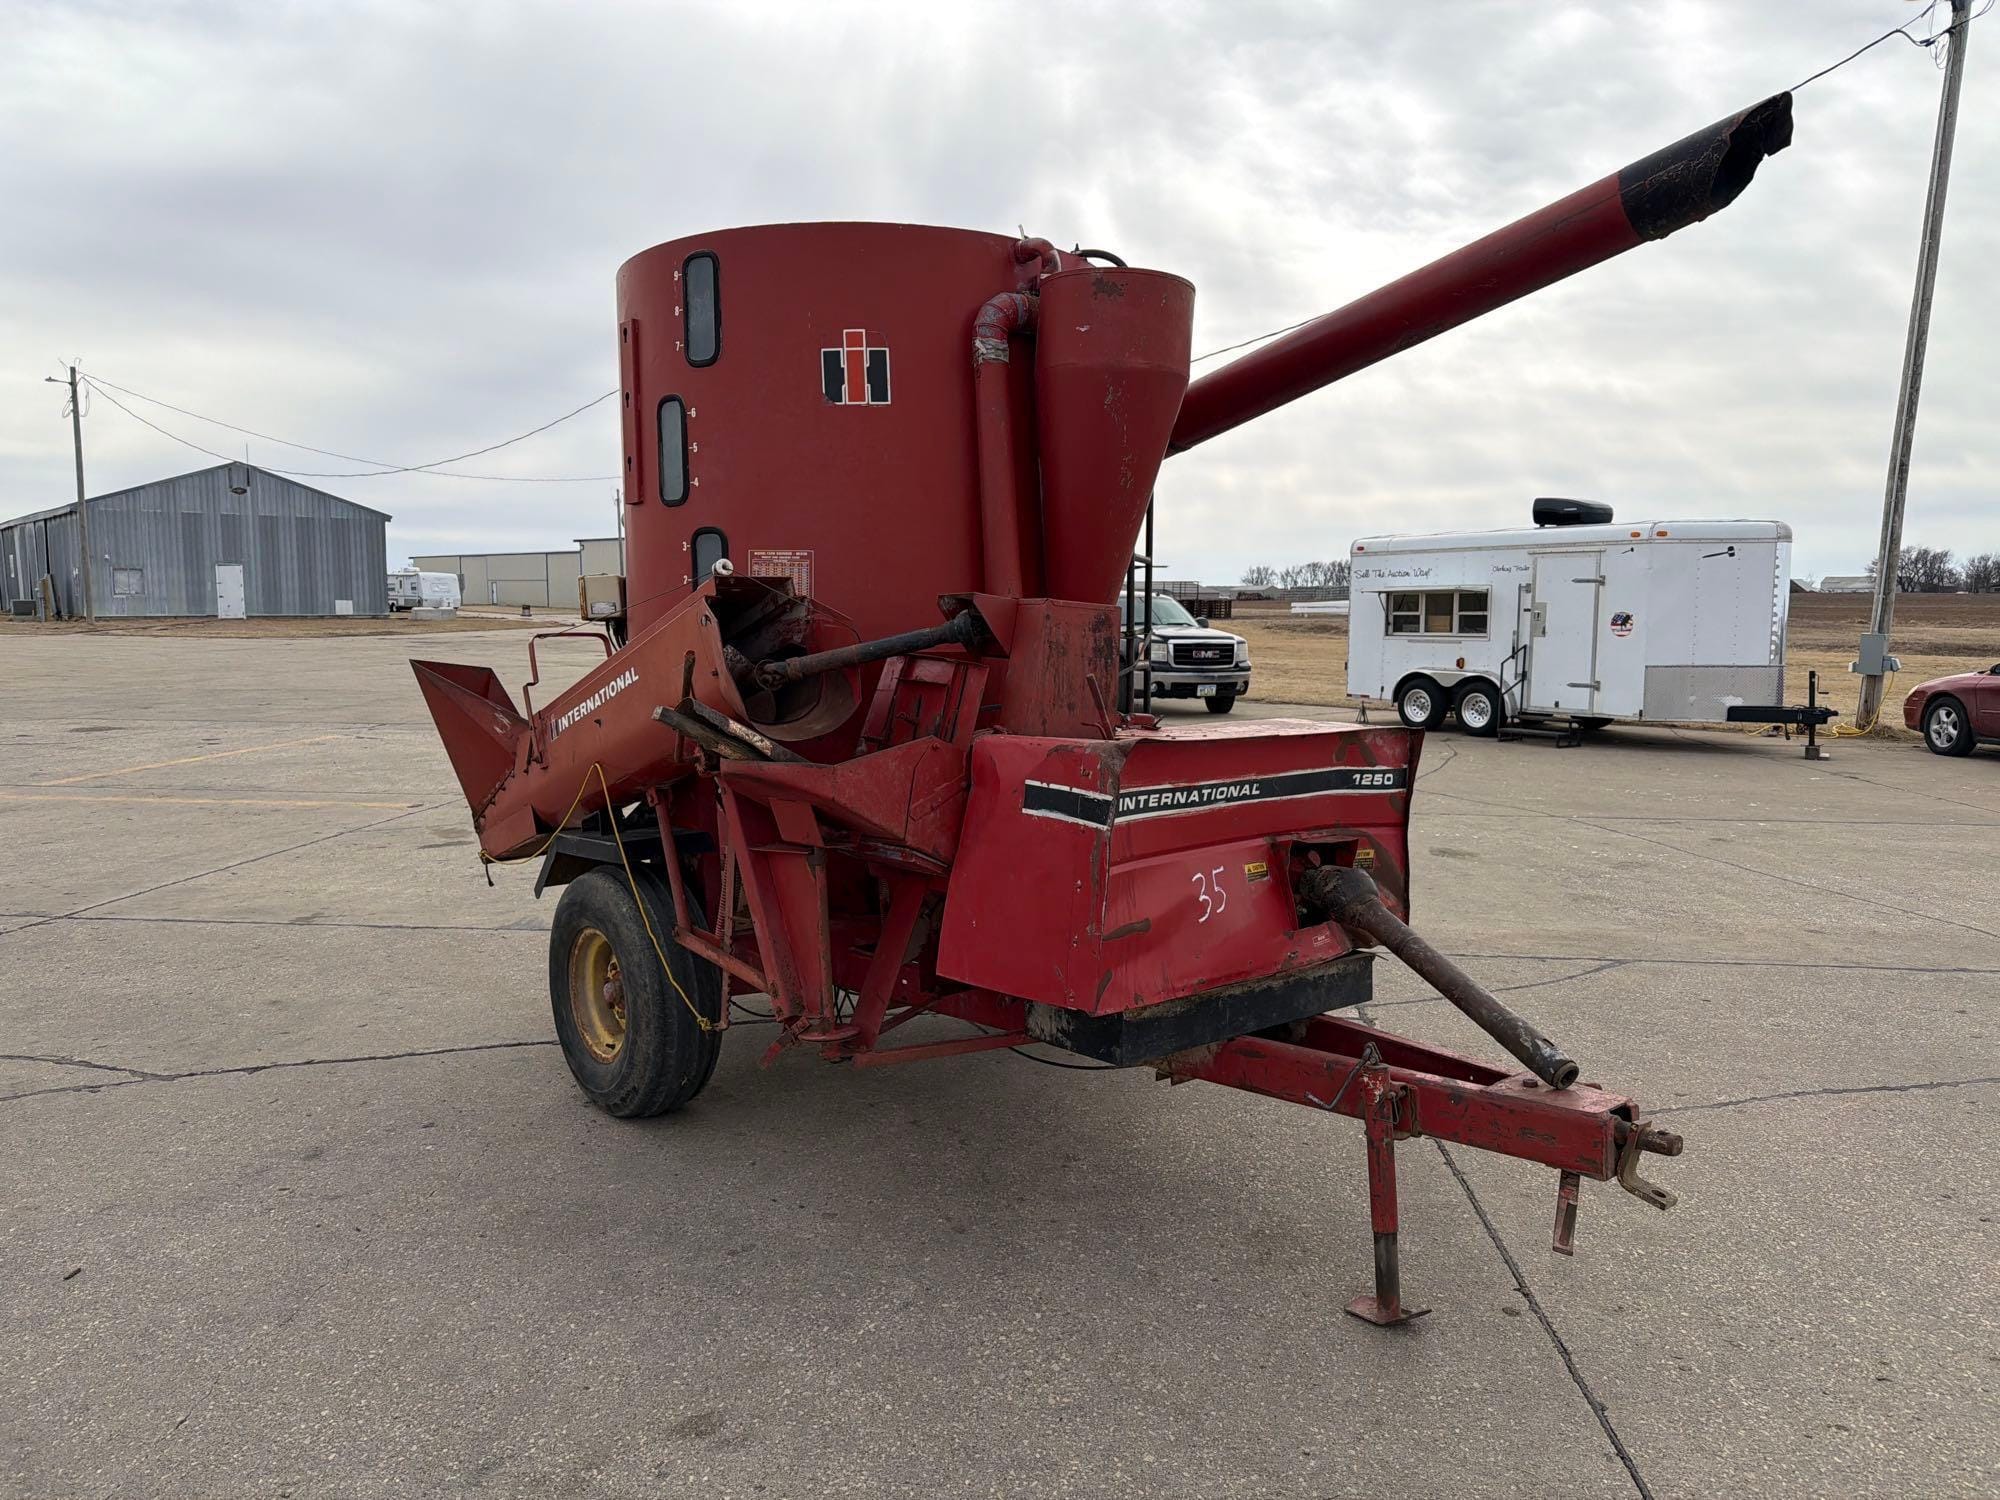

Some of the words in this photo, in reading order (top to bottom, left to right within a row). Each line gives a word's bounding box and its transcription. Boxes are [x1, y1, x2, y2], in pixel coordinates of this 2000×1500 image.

[673, 270, 679, 281] 9
[674, 305, 680, 316] 8
[675, 341, 680, 352] 7
[691, 407, 697, 418] 6
[692, 442, 698, 453] 5
[693, 477, 699, 487] 4
[682, 541, 687, 552] 3
[1193, 650, 1220, 659] GMC
[558, 667, 639, 732] INTERNATIONAL
[1119, 783, 1260, 811] INTERNATIONAL
[1352, 773, 1394, 785] 1250
[1192, 865, 1227, 923] 35
